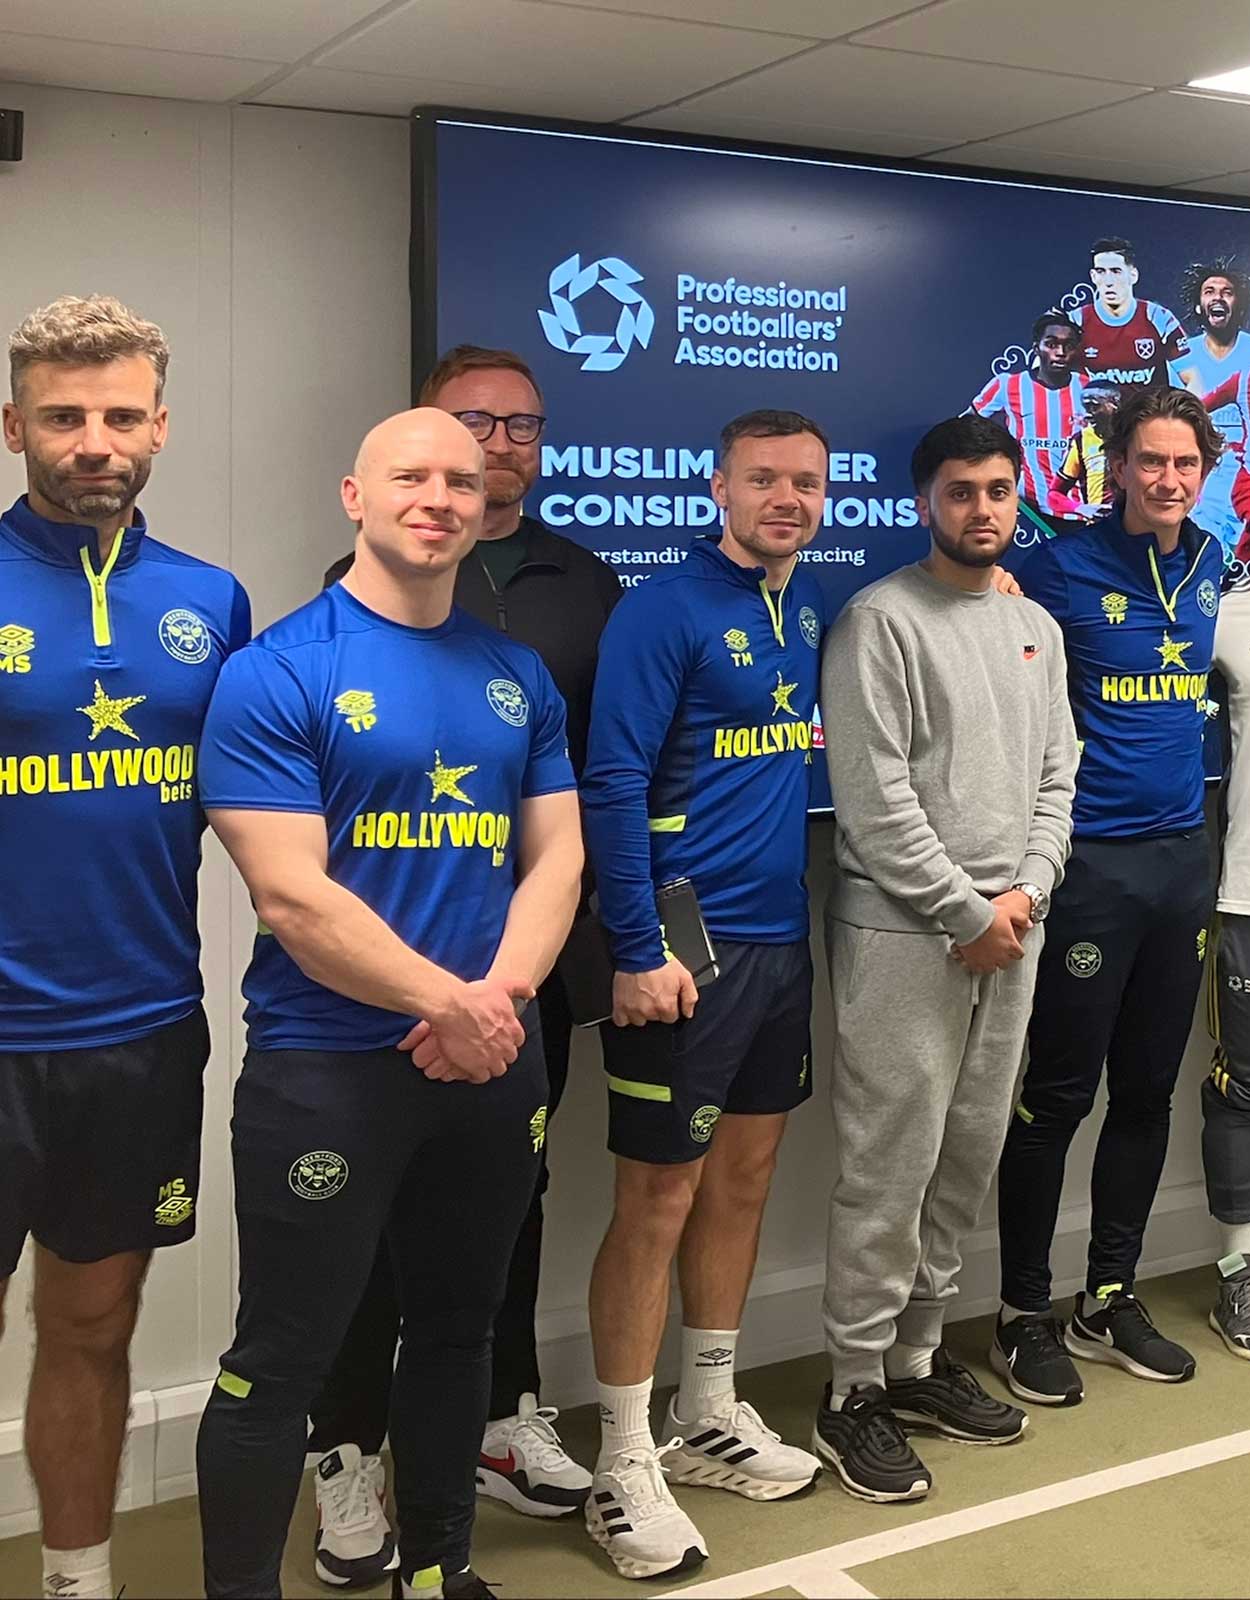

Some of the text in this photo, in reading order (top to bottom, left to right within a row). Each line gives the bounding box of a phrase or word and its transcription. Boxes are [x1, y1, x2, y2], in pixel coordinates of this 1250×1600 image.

[677, 274, 847, 311] Professional
[677, 306, 842, 342] Footballers'
[674, 338, 839, 371] Association
[541, 446, 714, 479] MUSLIM
[540, 493, 920, 527] CONSIDIONS
[1105, 613, 1125, 624] TF
[731, 652, 753, 667] TM
[351, 715, 377, 733] TP
[0, 745, 193, 796] HOLLYWOOD
[160, 781, 193, 803] bets
[158, 1178, 186, 1201] MS
